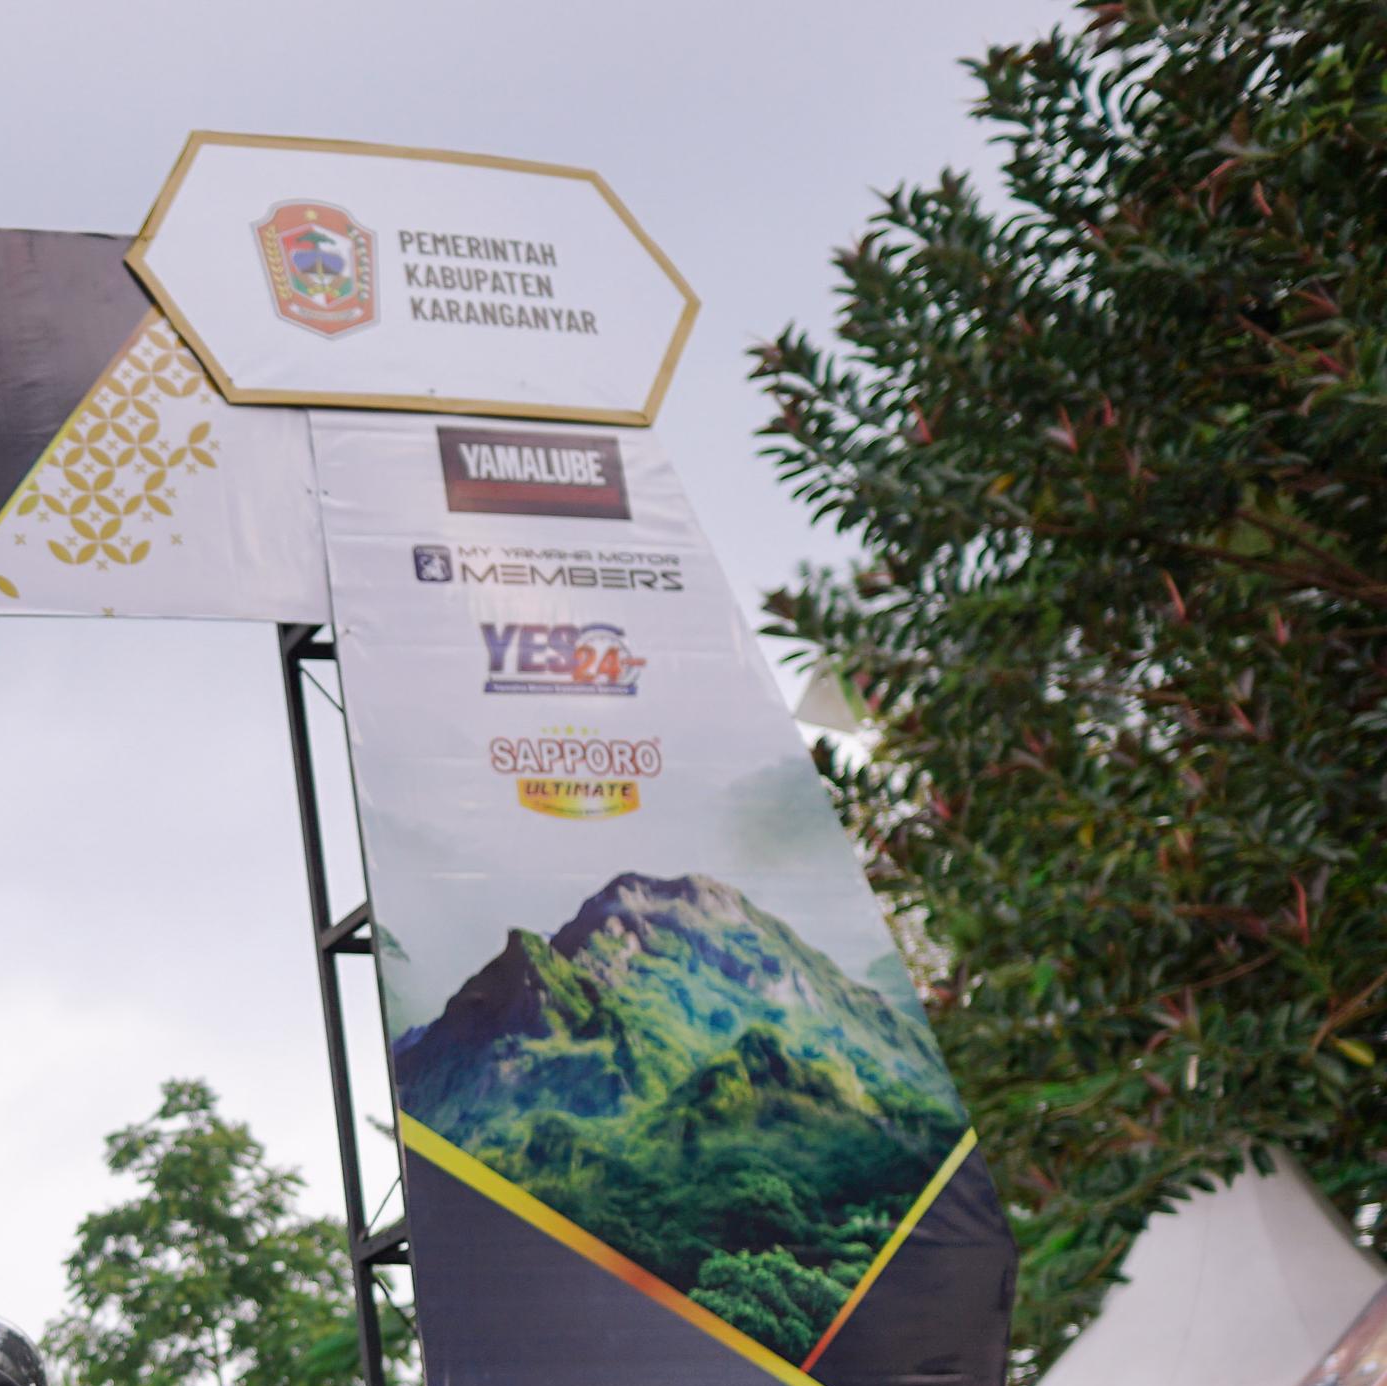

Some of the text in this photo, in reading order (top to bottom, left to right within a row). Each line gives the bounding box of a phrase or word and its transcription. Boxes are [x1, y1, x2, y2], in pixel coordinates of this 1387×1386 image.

[398, 230, 558, 268] PEMERINTAH
[404, 264, 554, 299] KABUPATEN
[410, 297, 598, 335] KARANGANYAR
[458, 442, 606, 486] YAMALUBE
[458, 546, 680, 565] MY YAMAHA MOTOR
[460, 564, 684, 591] MEMBERS
[481, 623, 621, 684] YES 24
[490, 737, 662, 778] SAPPORO
[525, 781, 633, 798] ULTIMATE
